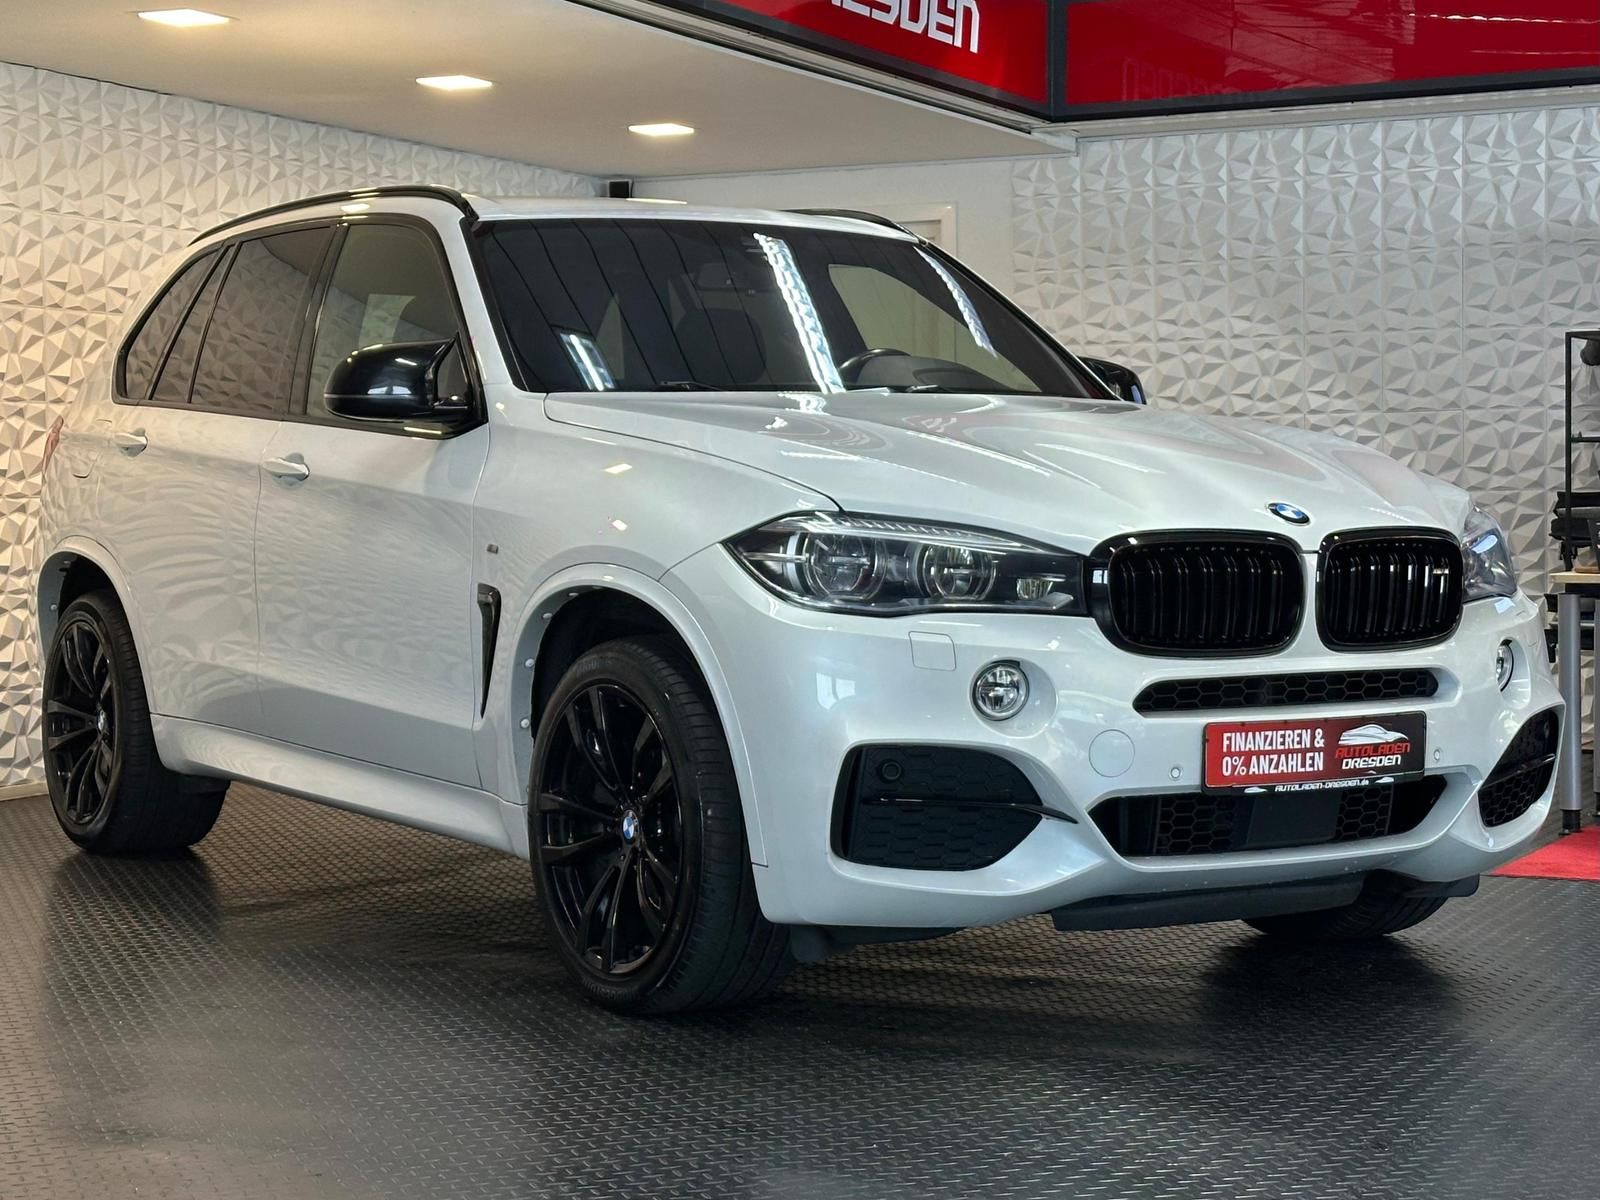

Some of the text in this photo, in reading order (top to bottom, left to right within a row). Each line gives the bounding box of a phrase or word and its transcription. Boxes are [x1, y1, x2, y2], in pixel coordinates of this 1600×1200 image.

[1222, 728, 1325, 753] FINANZIEREN &
[1334, 742, 1411, 758] AUTOLADEN
[1222, 752, 1324, 777] 0% ANZAHLEN
[1341, 755, 1401, 770] DRESDEN
